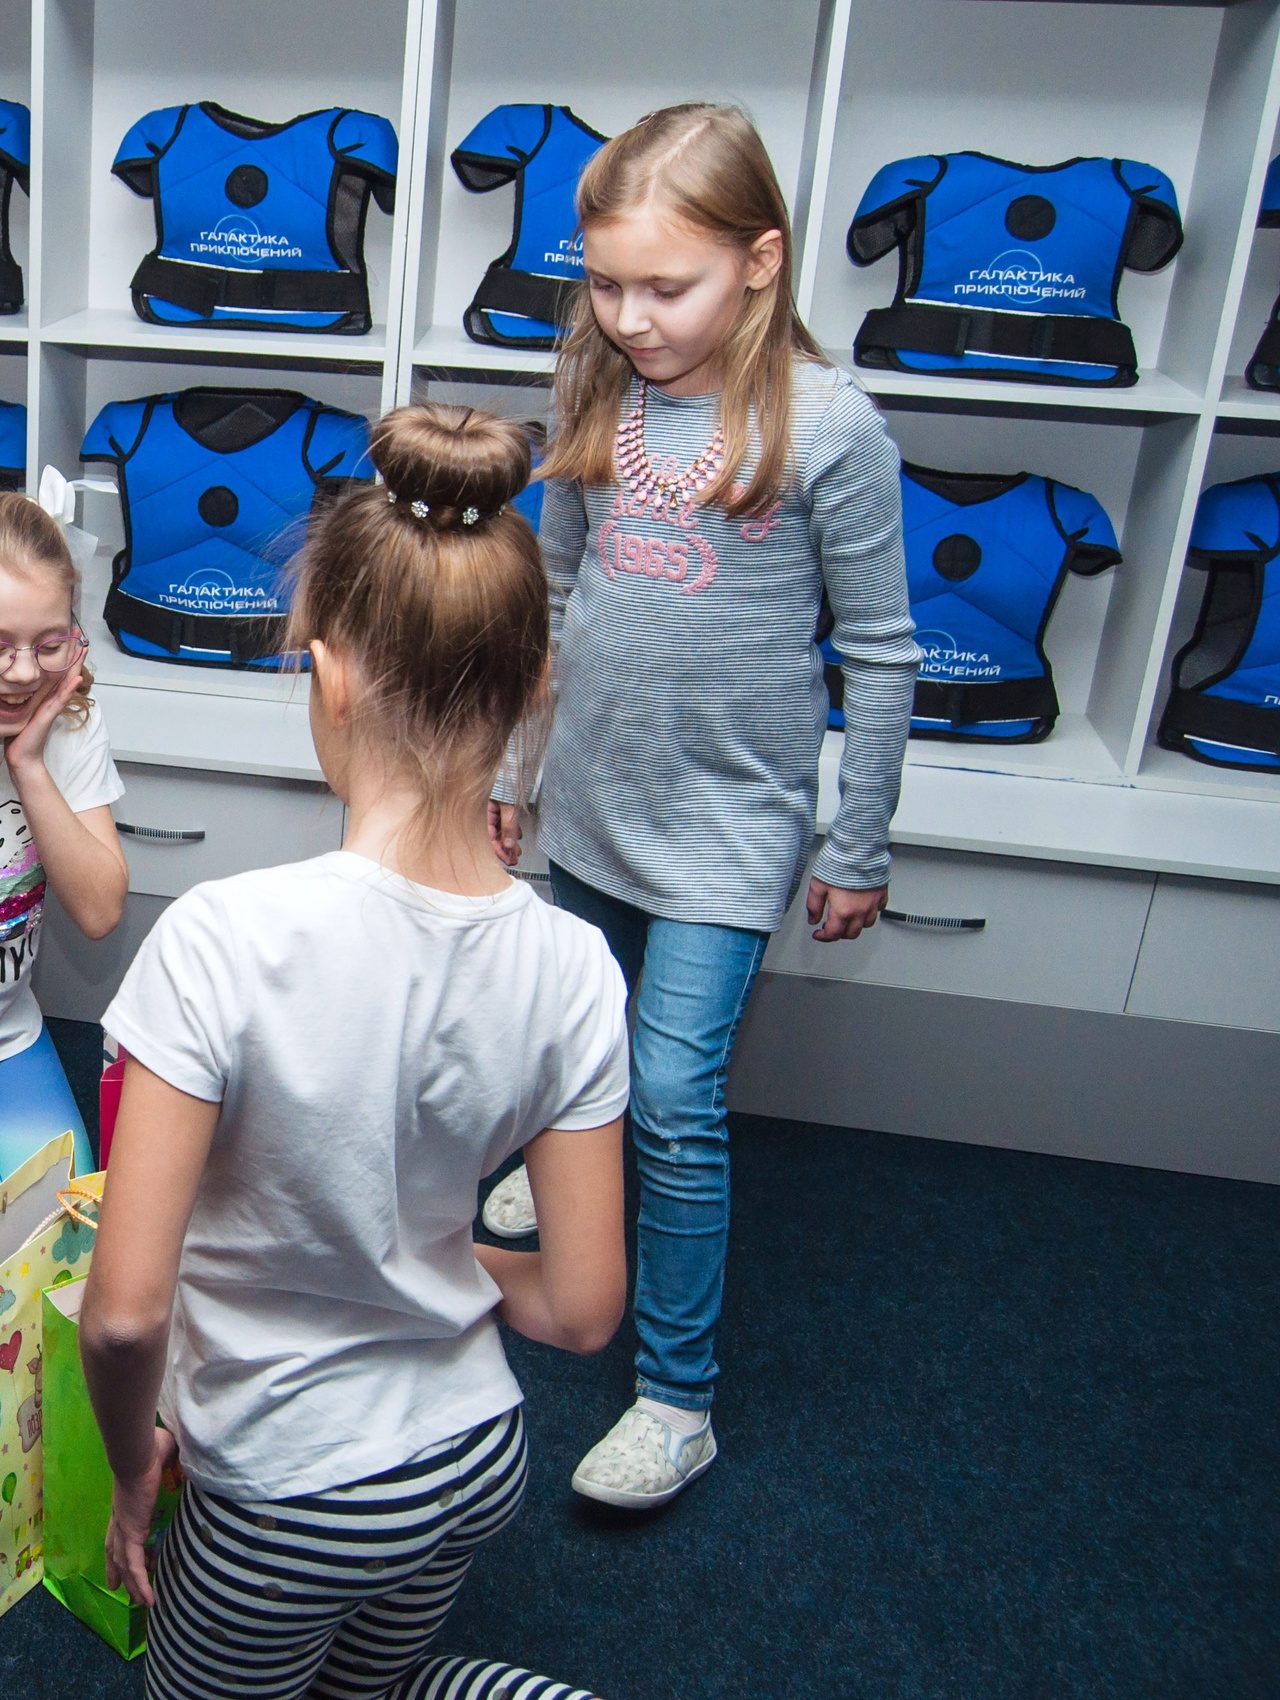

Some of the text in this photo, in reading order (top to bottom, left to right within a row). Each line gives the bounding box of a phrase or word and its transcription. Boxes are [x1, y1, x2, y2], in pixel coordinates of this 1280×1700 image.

[200, 231, 289, 245] ГАЛАКТИКА
[190, 243, 302, 257] ПРИКЛЮЧЕНИЙ
[969, 269, 1075, 284] ГАЛАКТИКА
[954, 284, 1087, 299] ПРИКЛЮЧЕНИЙ
[612, 532, 689, 582] 1965
[168, 584, 266, 597] ГАЛАКТИКА
[159, 594, 278, 610] ПРИКЛЮЧЕНИЙ
[921, 648, 990, 663] АКТИКА
[920, 663, 1001, 676] ЮЧЕНИЙ
